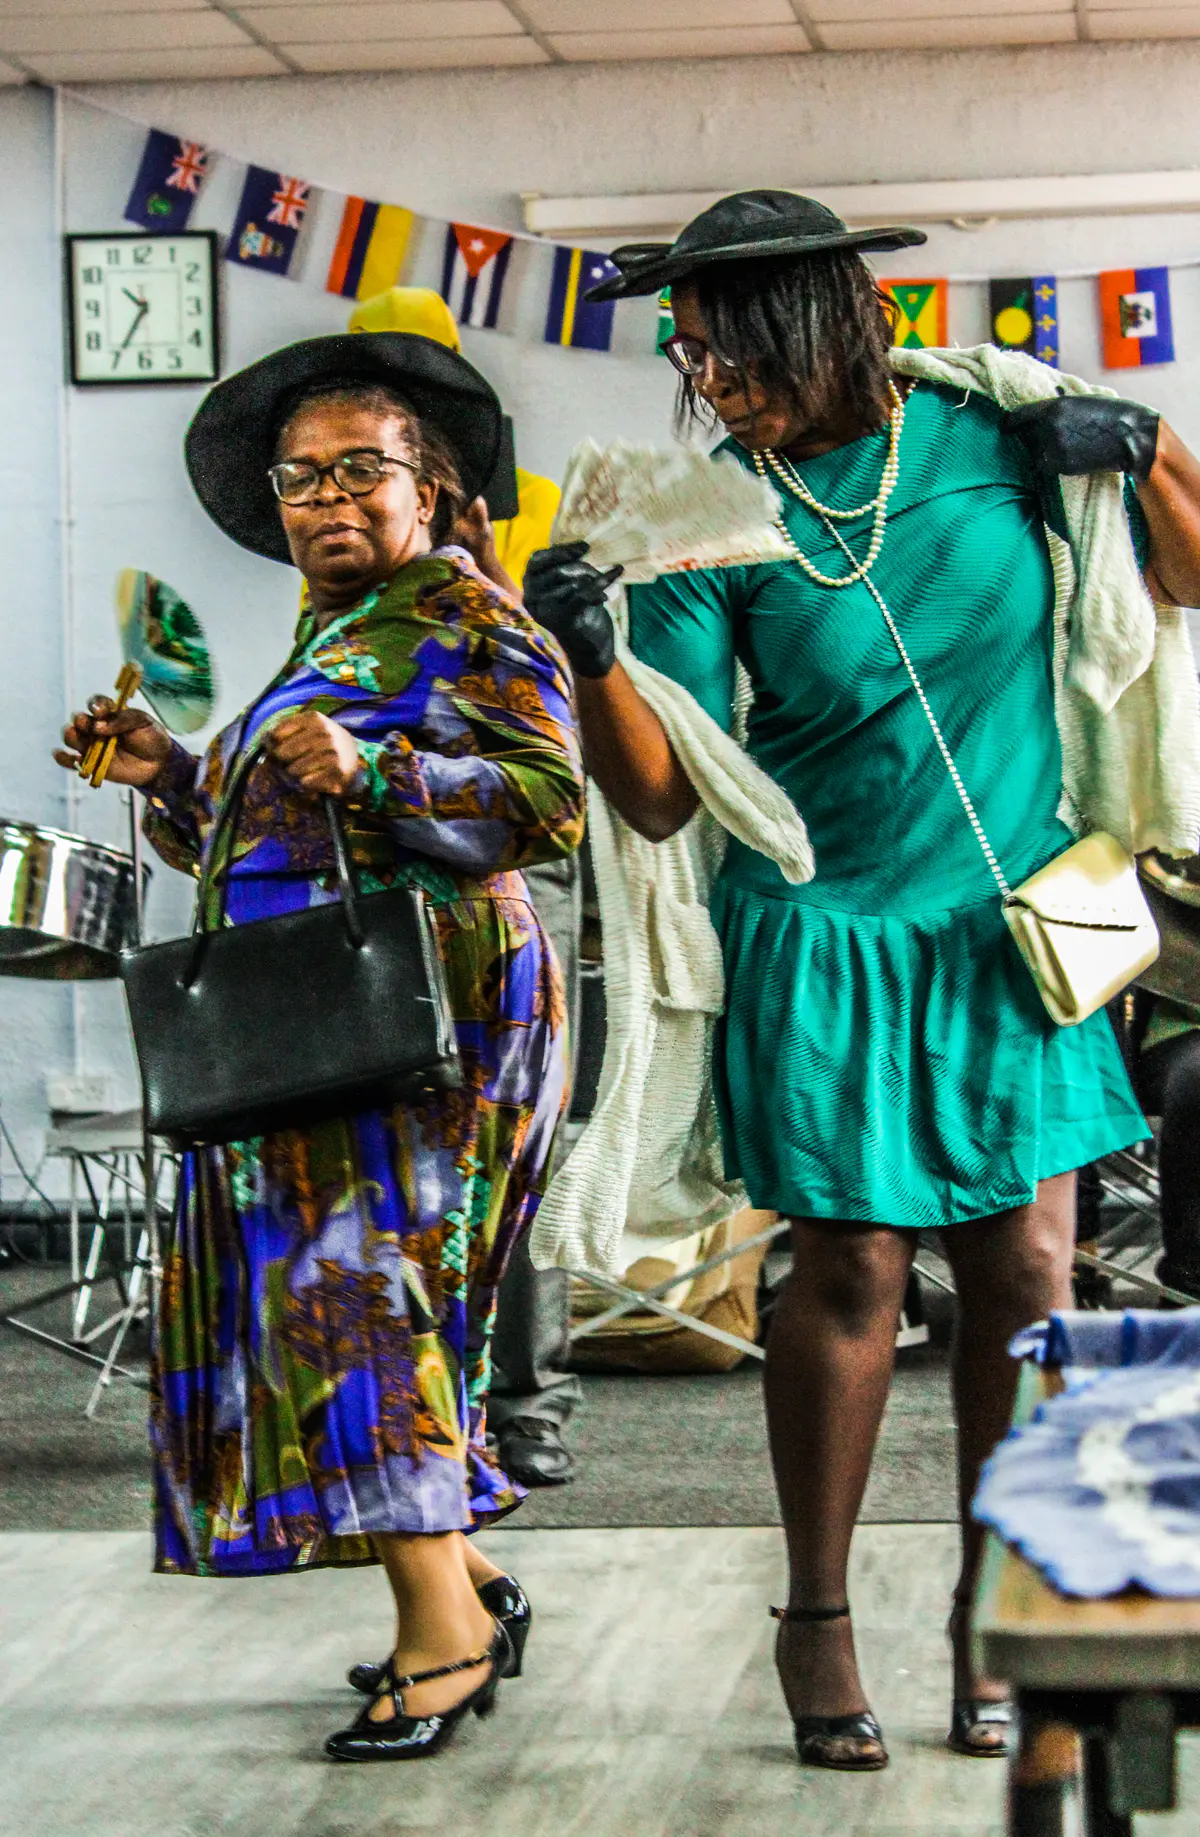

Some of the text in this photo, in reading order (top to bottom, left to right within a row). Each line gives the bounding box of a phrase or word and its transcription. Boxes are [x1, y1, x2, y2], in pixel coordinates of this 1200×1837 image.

[107, 245, 176, 265] 11 12 1
[82, 266, 103, 284] 10
[185, 262, 200, 282] 2
[86, 300, 99, 318] 9
[187, 296, 202, 316] 3
[86, 330, 101, 351] 8
[188, 329, 202, 348] 4
[110, 349, 182, 370] 7 6 5
